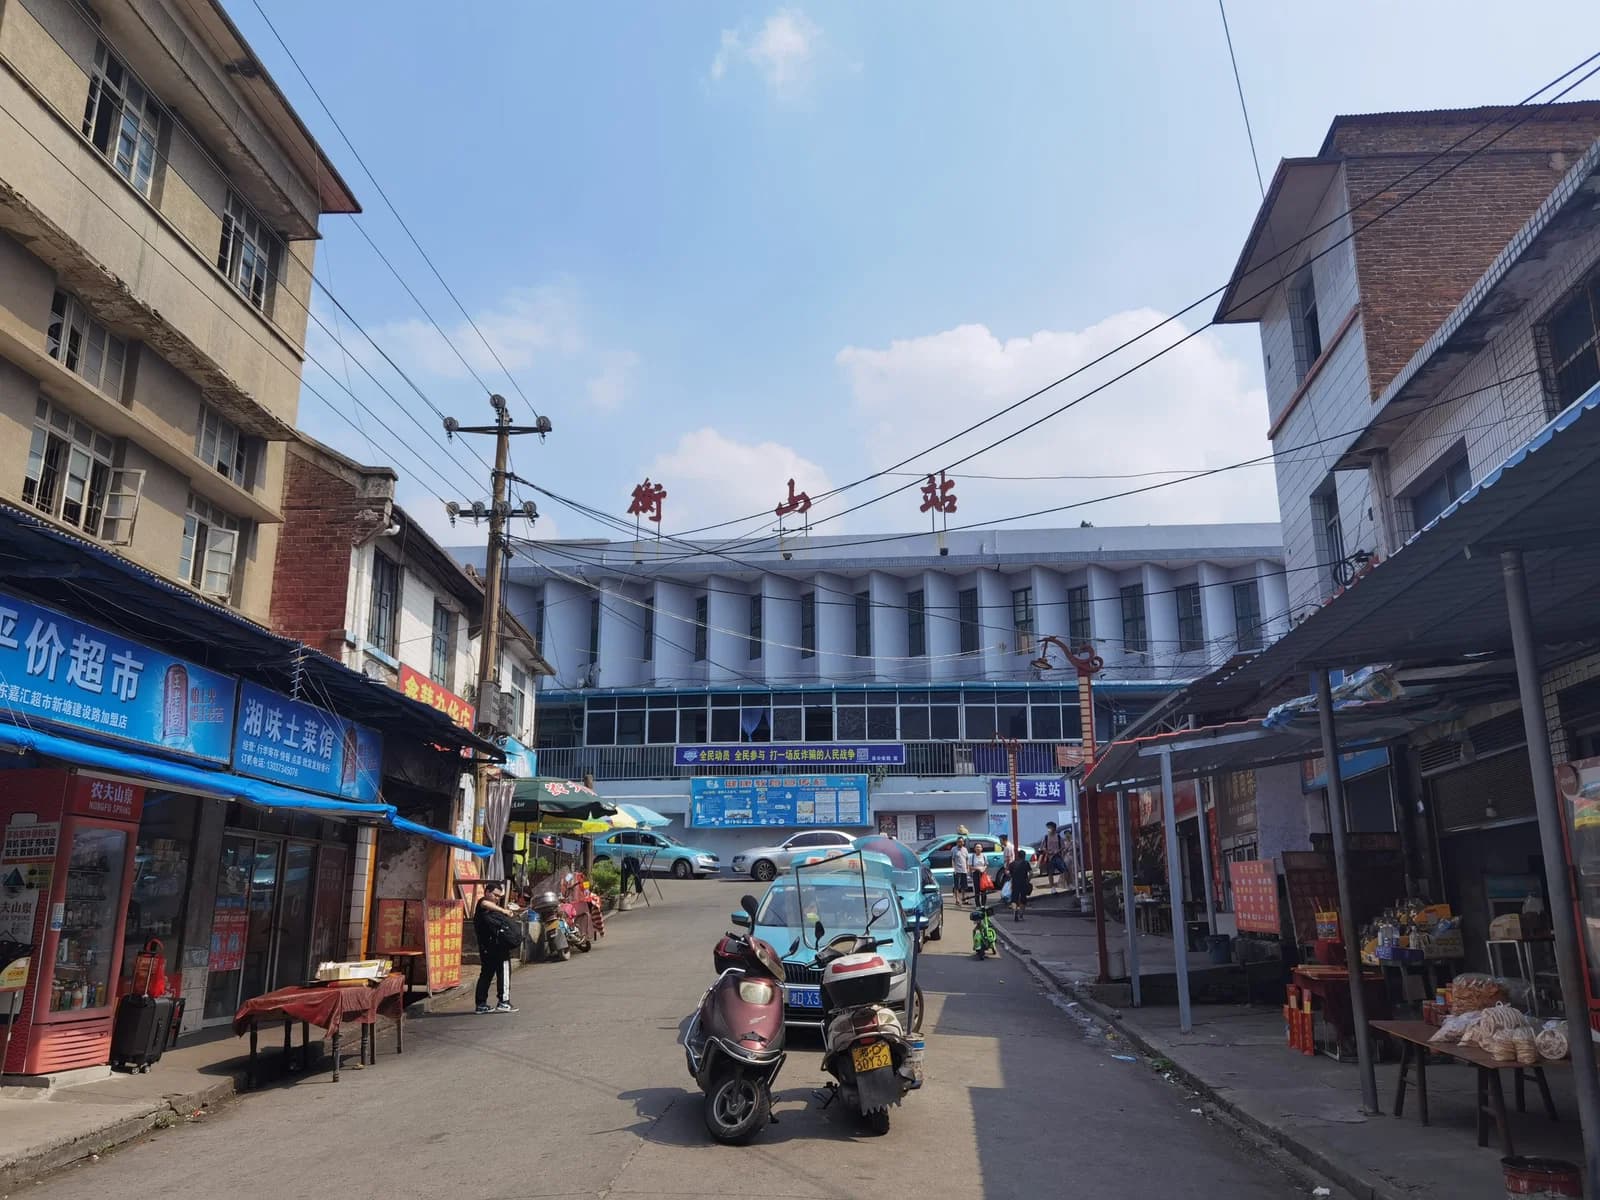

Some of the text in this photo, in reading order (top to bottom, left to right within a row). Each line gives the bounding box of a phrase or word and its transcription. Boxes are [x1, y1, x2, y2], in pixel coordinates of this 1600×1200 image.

[627, 471, 957, 522] 衡山站
[243, 698, 334, 760] 湘味土菜馆
[700, 749, 856, 761] 全民动员 全民参与 打一场反诈骗的人民战争
[91, 782, 133, 804] 农夫山泉
